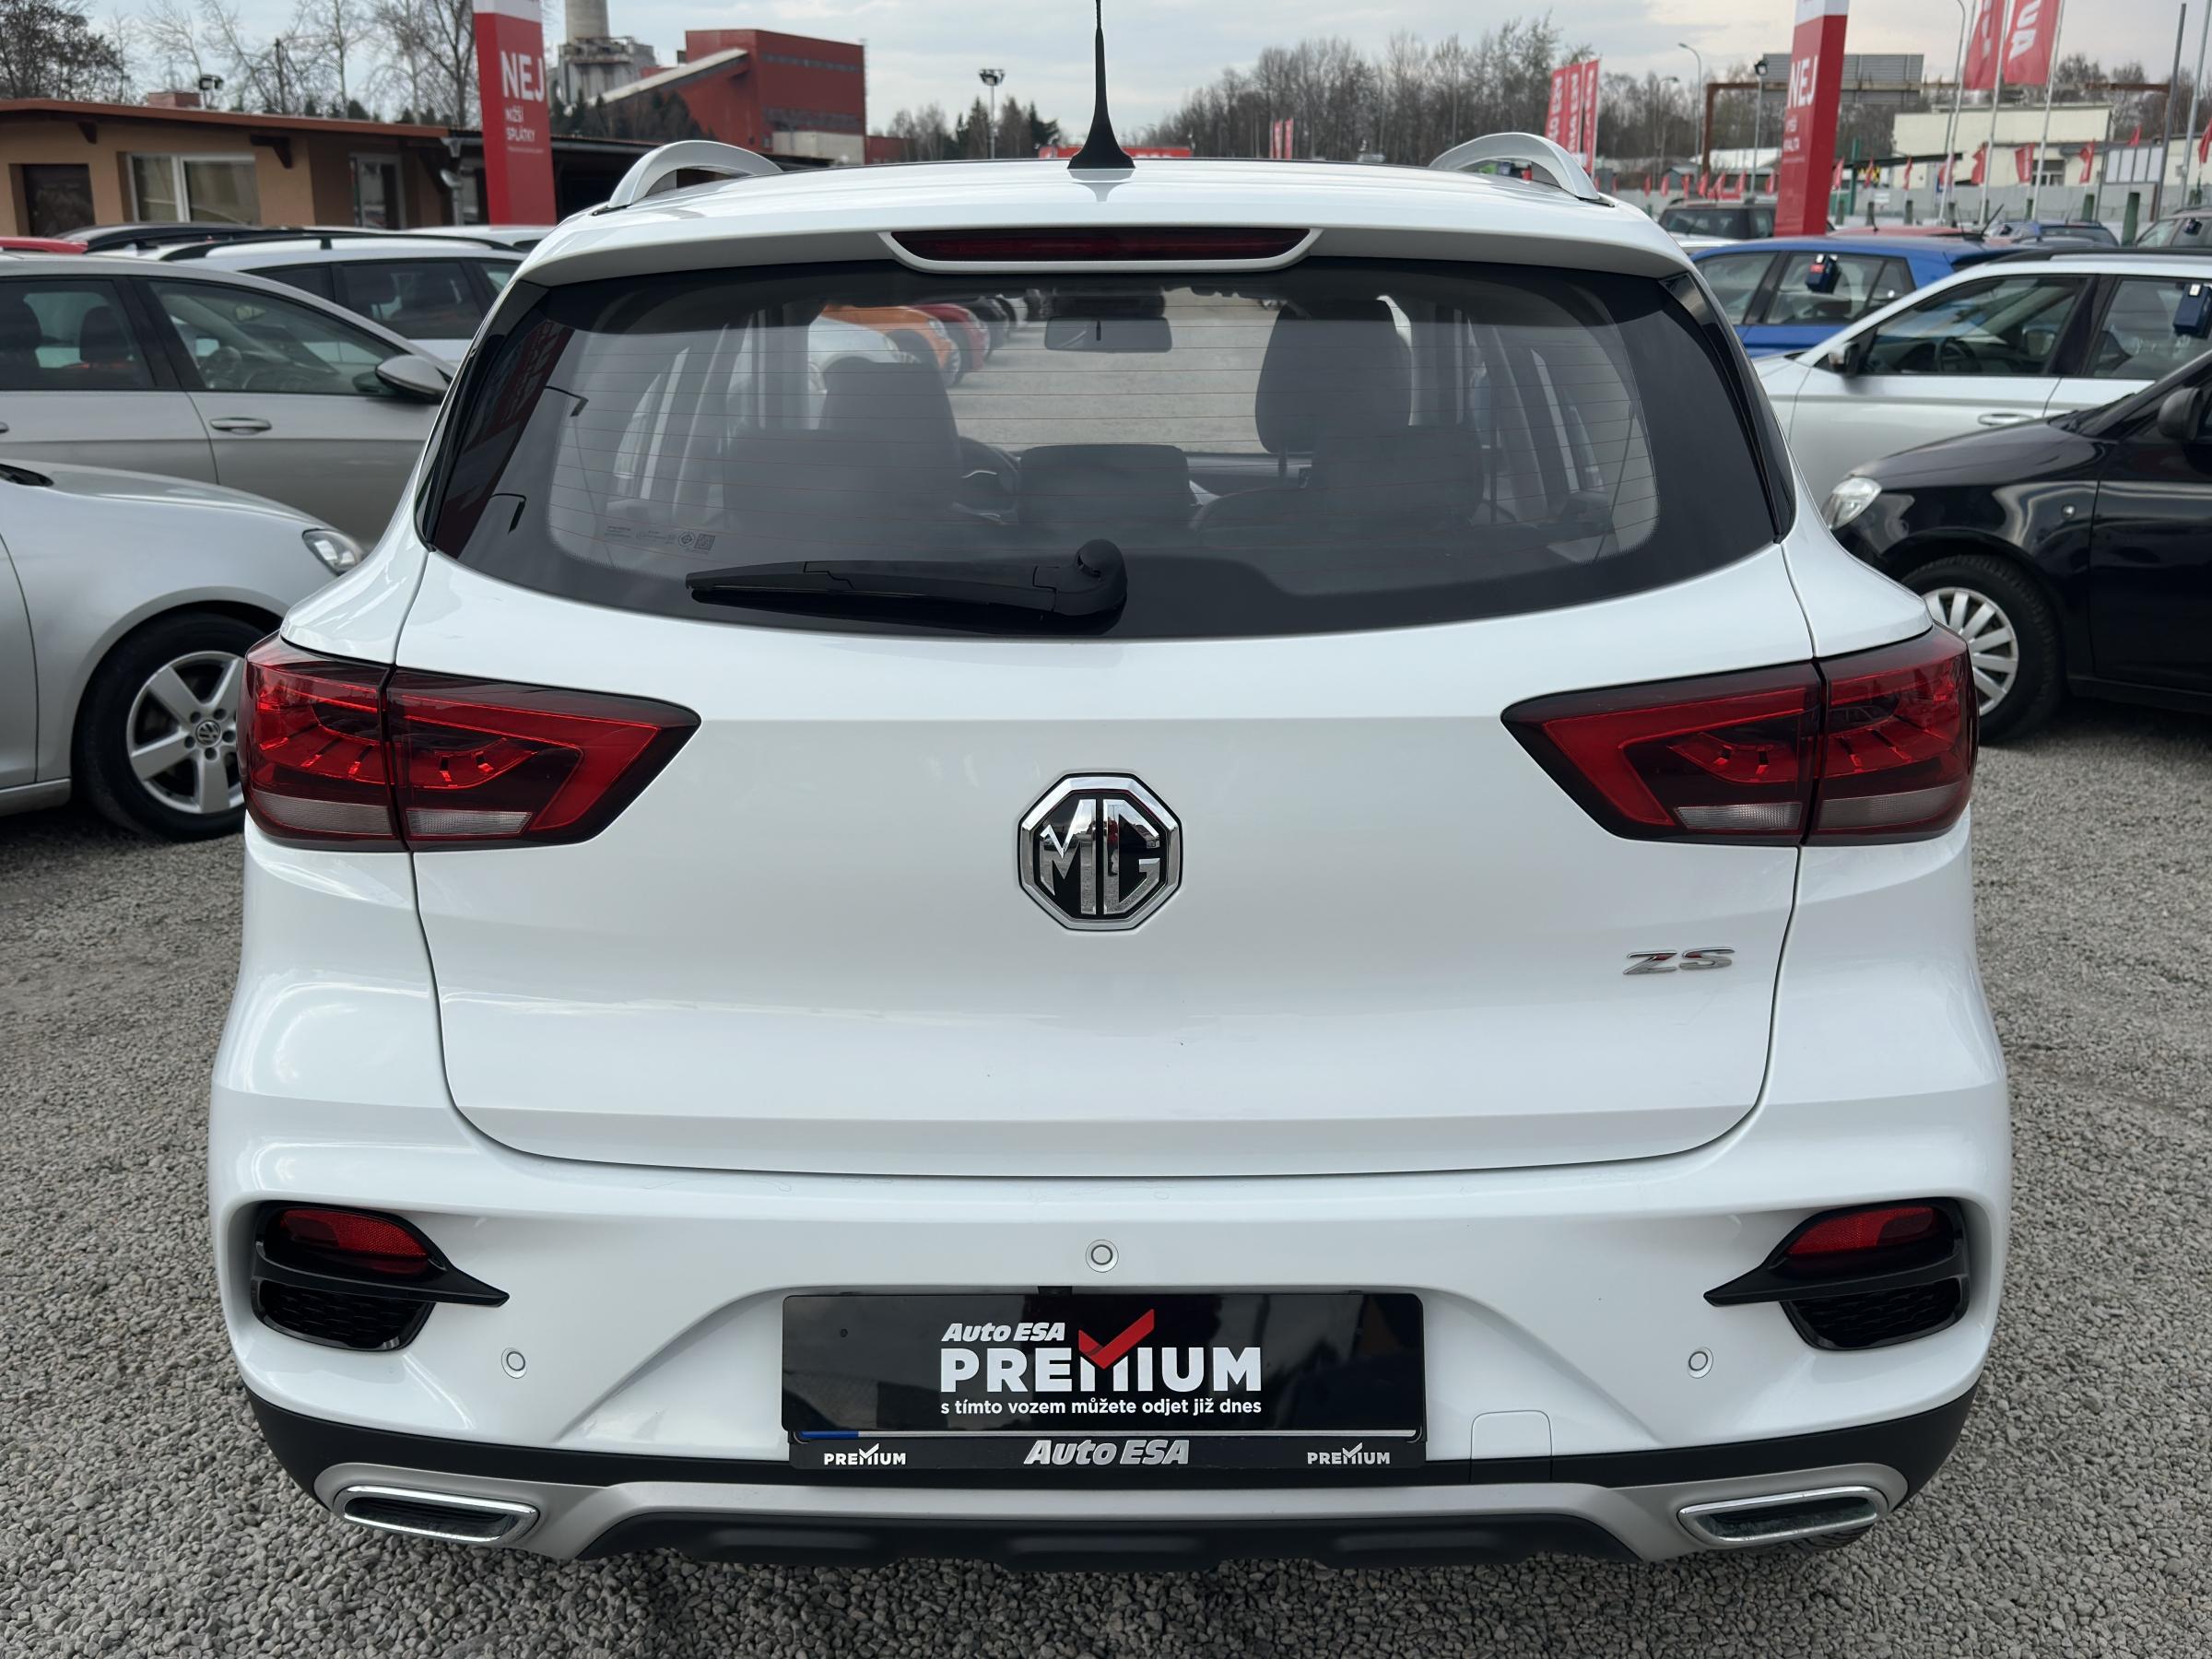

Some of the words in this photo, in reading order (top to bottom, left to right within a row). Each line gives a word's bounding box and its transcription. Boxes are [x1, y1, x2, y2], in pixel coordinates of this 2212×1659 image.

[500, 50, 546, 103] NEJ
[1787, 54, 1818, 109] NEJ
[1037, 795, 1163, 917] MG
[1622, 947, 1735, 975] ZS
[941, 1321, 1012, 1342] Auto
[1013, 1321, 1065, 1342] ESA
[940, 1329, 1262, 1393] PREMIUM
[940, 1402, 950, 1415] s
[955, 1397, 1003, 1415] tímto
[1007, 1401, 1066, 1415] vozem
[1071, 1397, 1137, 1415] můžete
[1141, 1398, 1189, 1417] odjet
[1192, 1397, 1215, 1417] již
[1219, 1398, 1262, 1415] dnes
[823, 1448, 907, 1466] PREMIUM
[1023, 1439, 1118, 1465] Auto
[1119, 1439, 1190, 1465] ESA
[1307, 1447, 1391, 1465] PREMIUM
